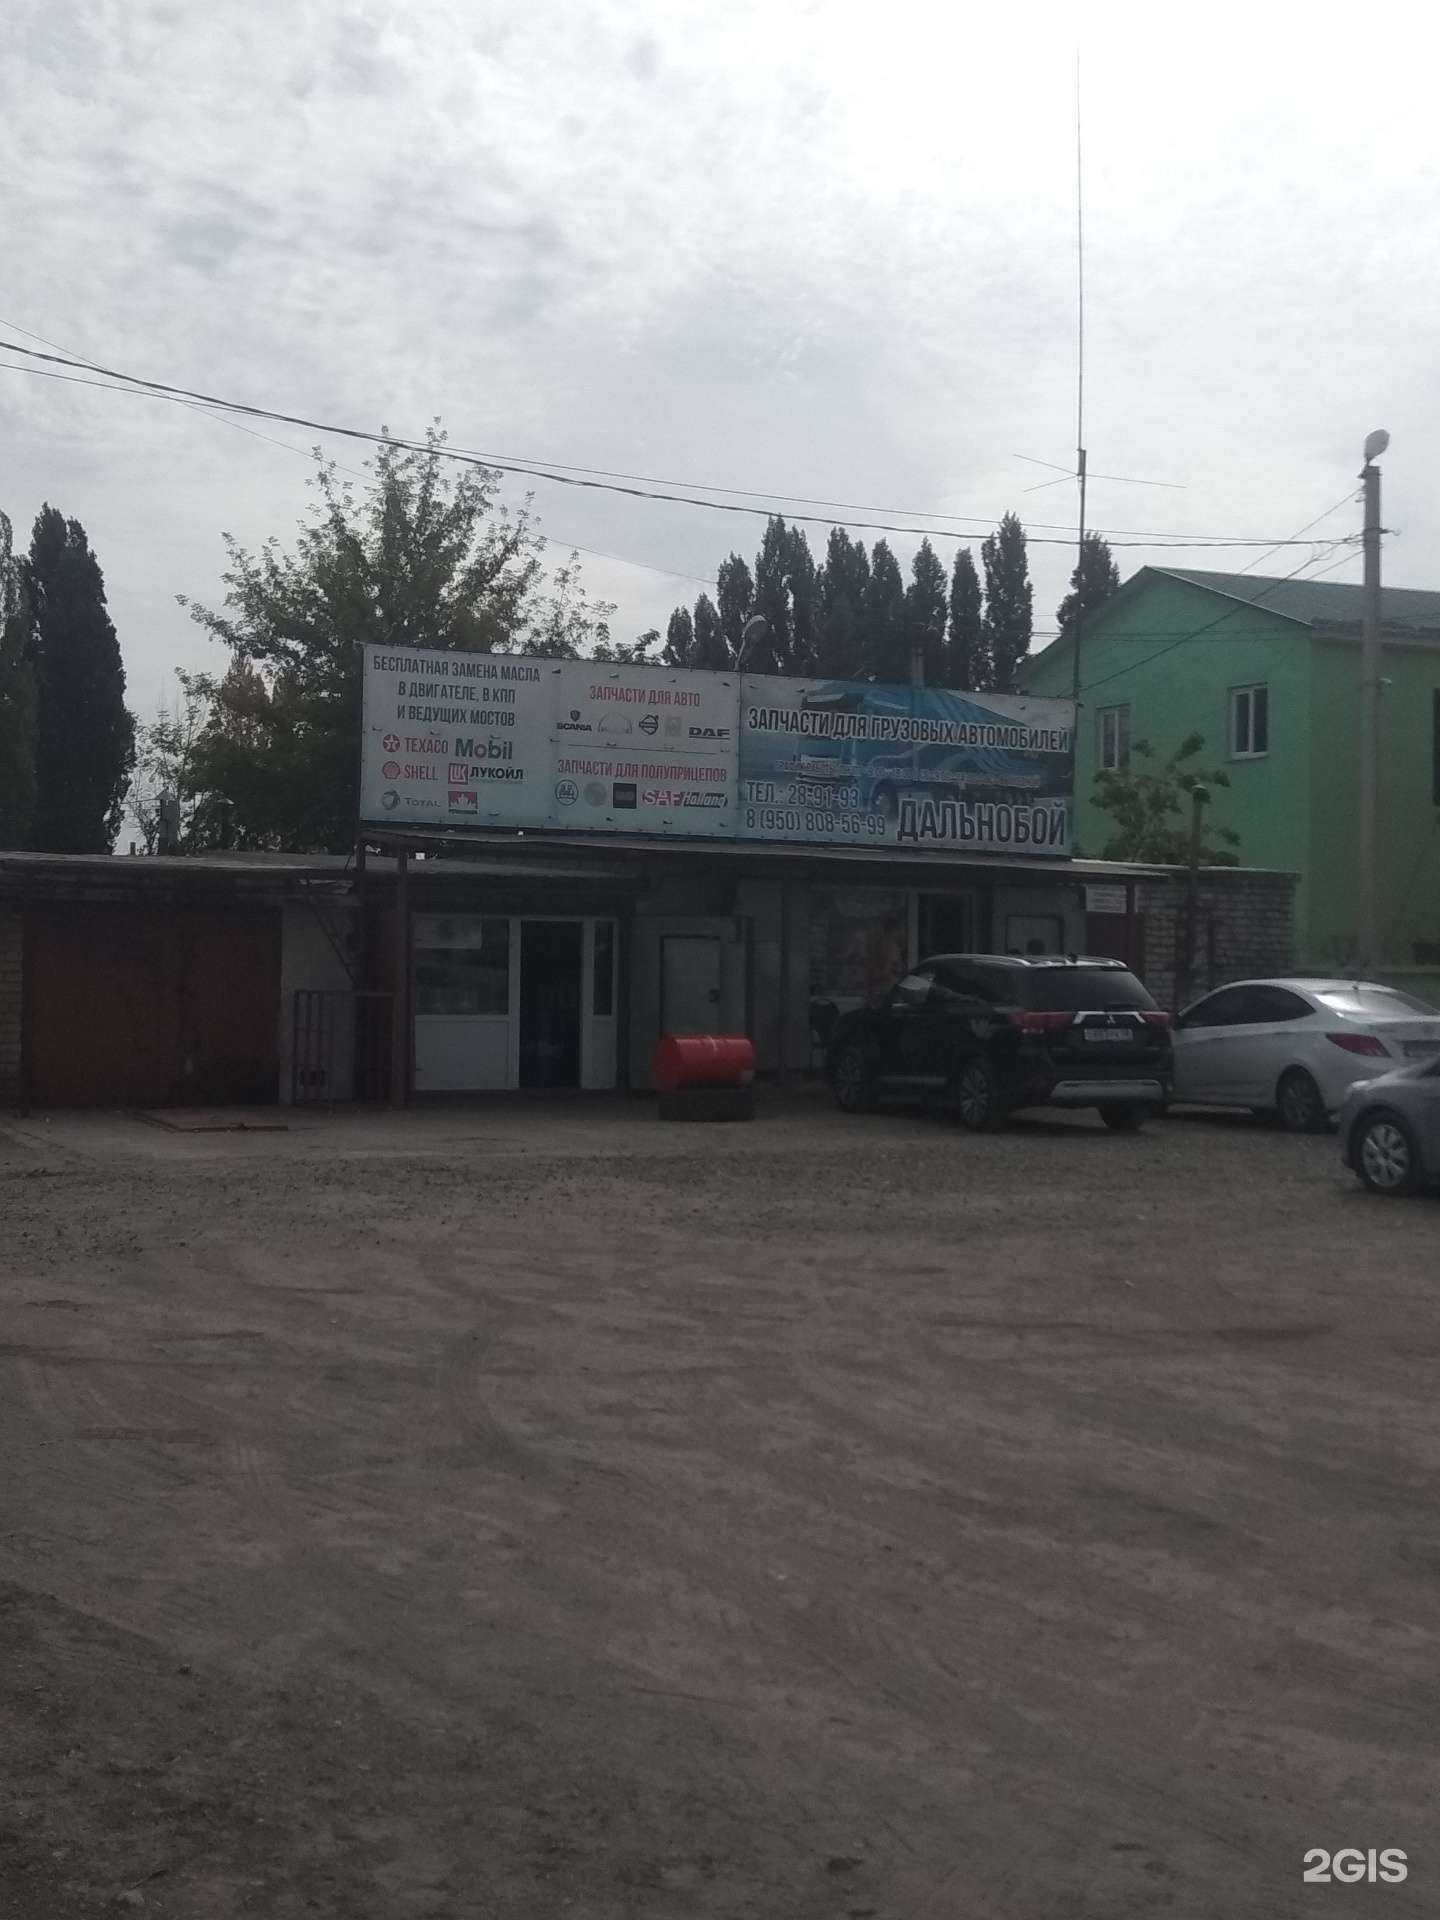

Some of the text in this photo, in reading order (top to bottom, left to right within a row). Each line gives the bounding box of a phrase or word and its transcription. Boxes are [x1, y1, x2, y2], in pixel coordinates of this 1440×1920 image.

[373, 655, 541, 682] БЕСПЛАТНАЯ ЗАМЕНА МАСЛА
[398, 681, 516, 704] В ДВИГАТЕЛЕ, В КПП
[589, 685, 700, 707] ЗАПЧАСТИ ДЛЯ АВТО
[397, 705, 515, 727] И ВЕДУЩИХ МОСТОВ
[556, 722, 592, 732] SCANIA
[688, 726, 730, 738] DAF
[749, 707, 1070, 751] ЗАПЧАСТИ ДЛЯ ГРУЗОВЫХ АВТОМОБИЛЕЙ
[404, 737, 513, 759] TEXACO Mobil
[404, 764, 438, 781] SHELL
[470, 766, 524, 780] ЛУКОЙЛ
[558, 759, 727, 783] ЗАПЧАСТИ ДЛЯ ПОЛУПРИЦЕПОВ
[747, 808, 885, 835] 8 (950) 808-56-99
[898, 799, 1067, 845] ДАЛЬНОБОЙ
